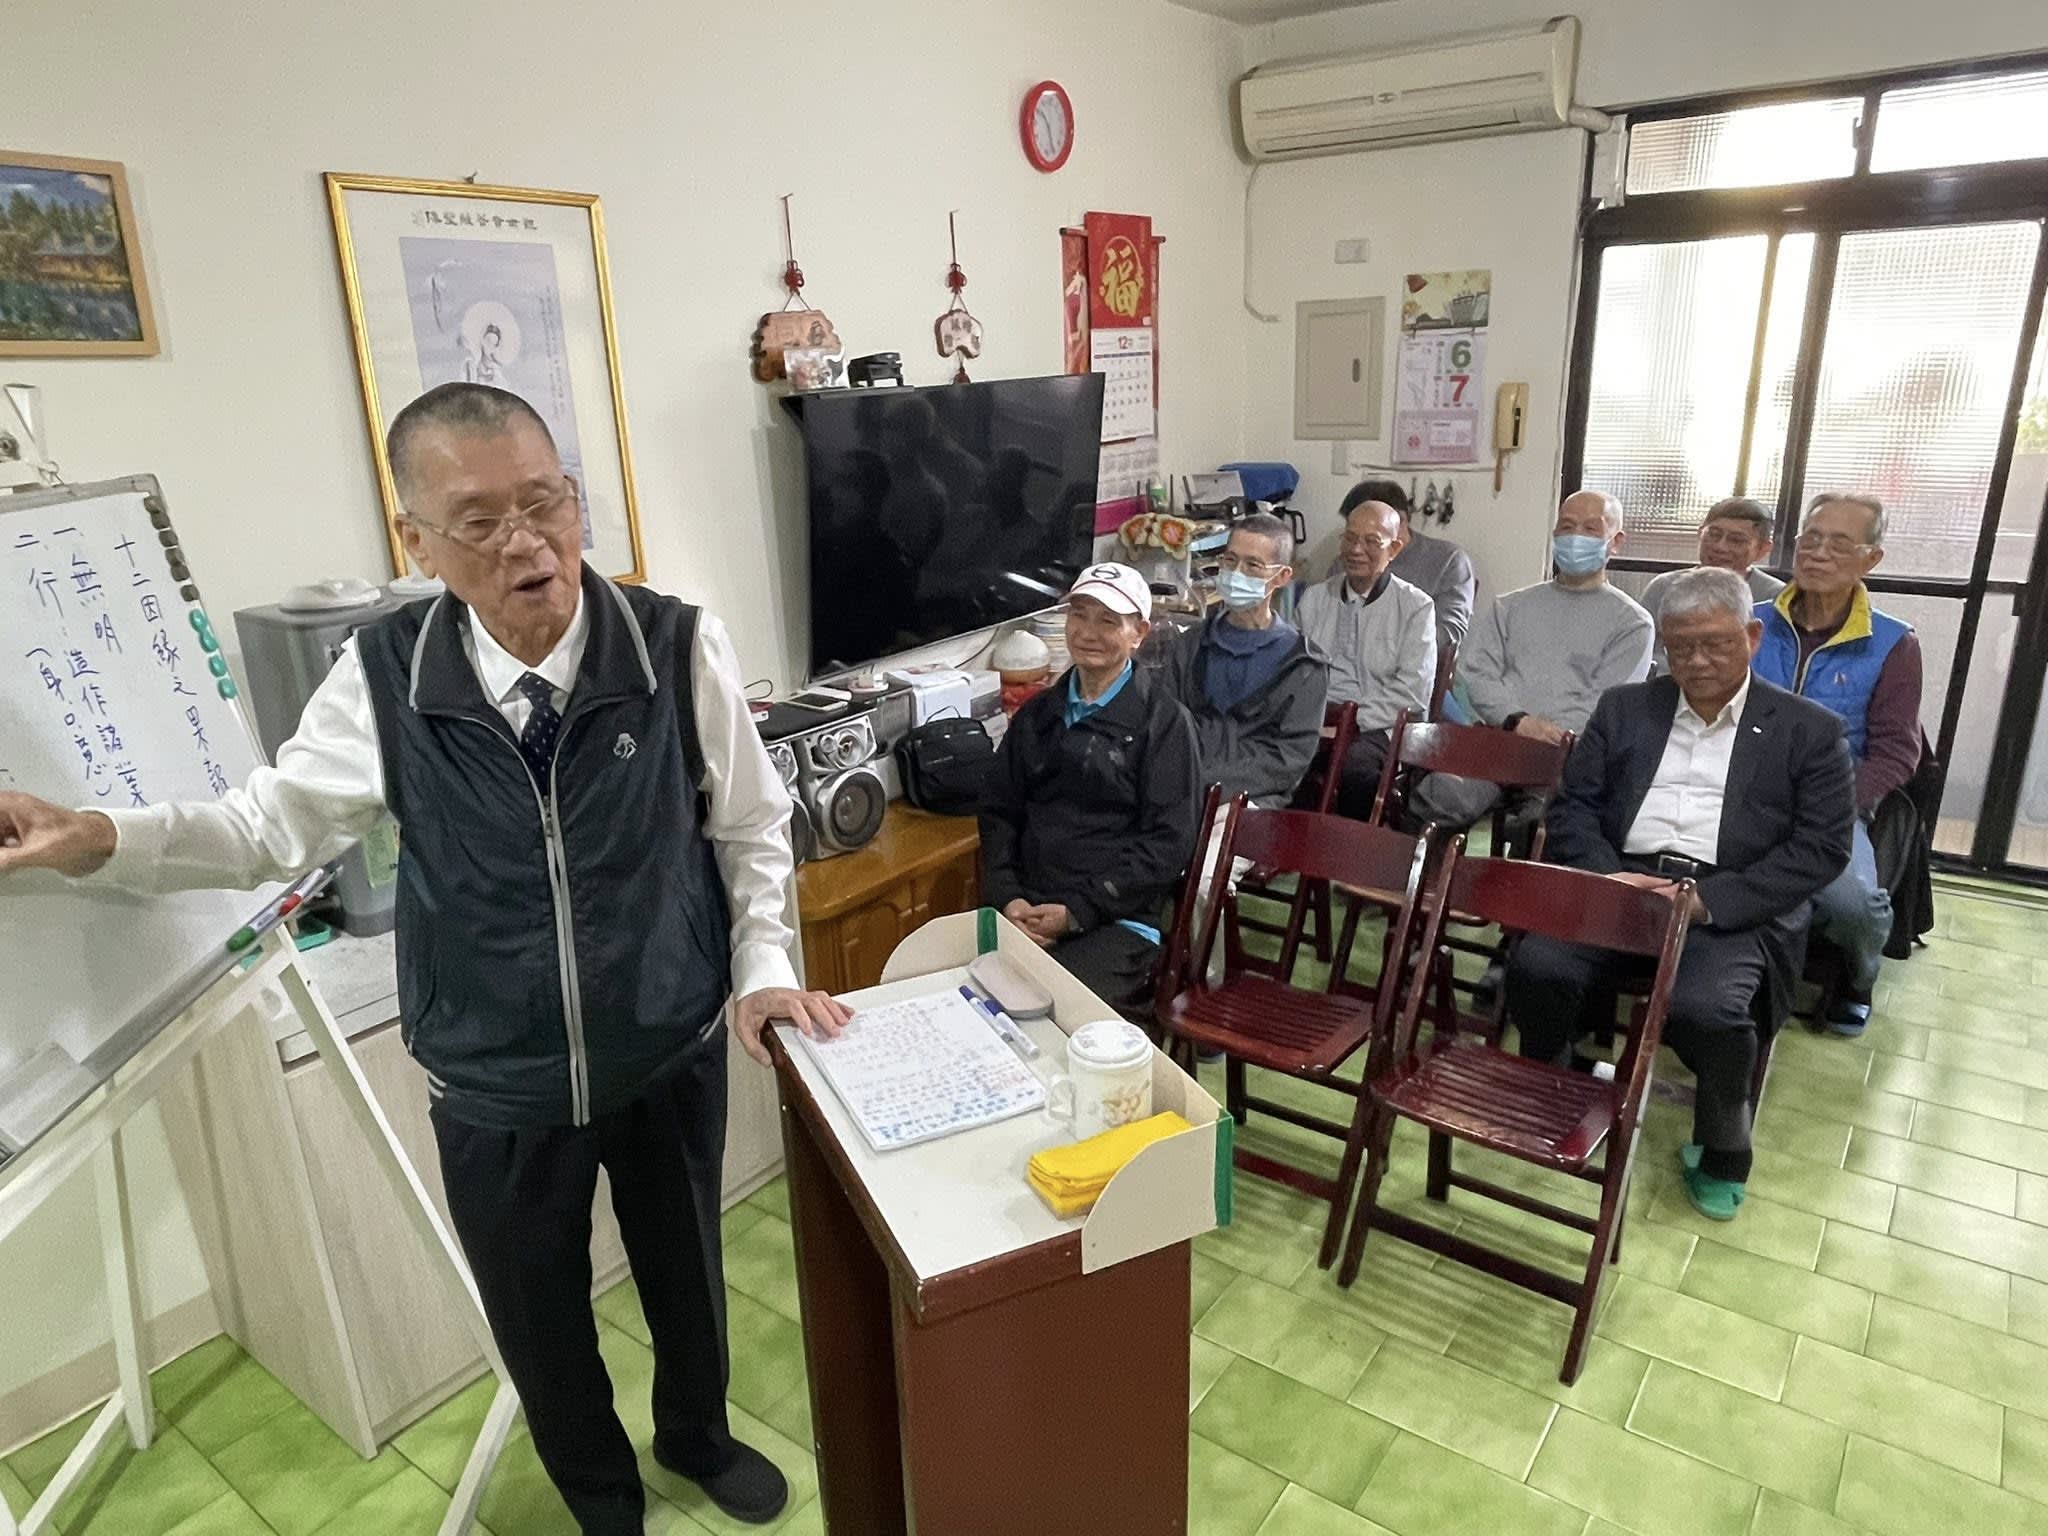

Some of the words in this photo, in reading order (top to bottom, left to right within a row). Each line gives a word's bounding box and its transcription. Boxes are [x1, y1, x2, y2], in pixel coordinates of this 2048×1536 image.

[1101, 245, 1142, 318] 福
[1451, 340, 1472, 368] 6
[1449, 374, 1470, 402] 7
